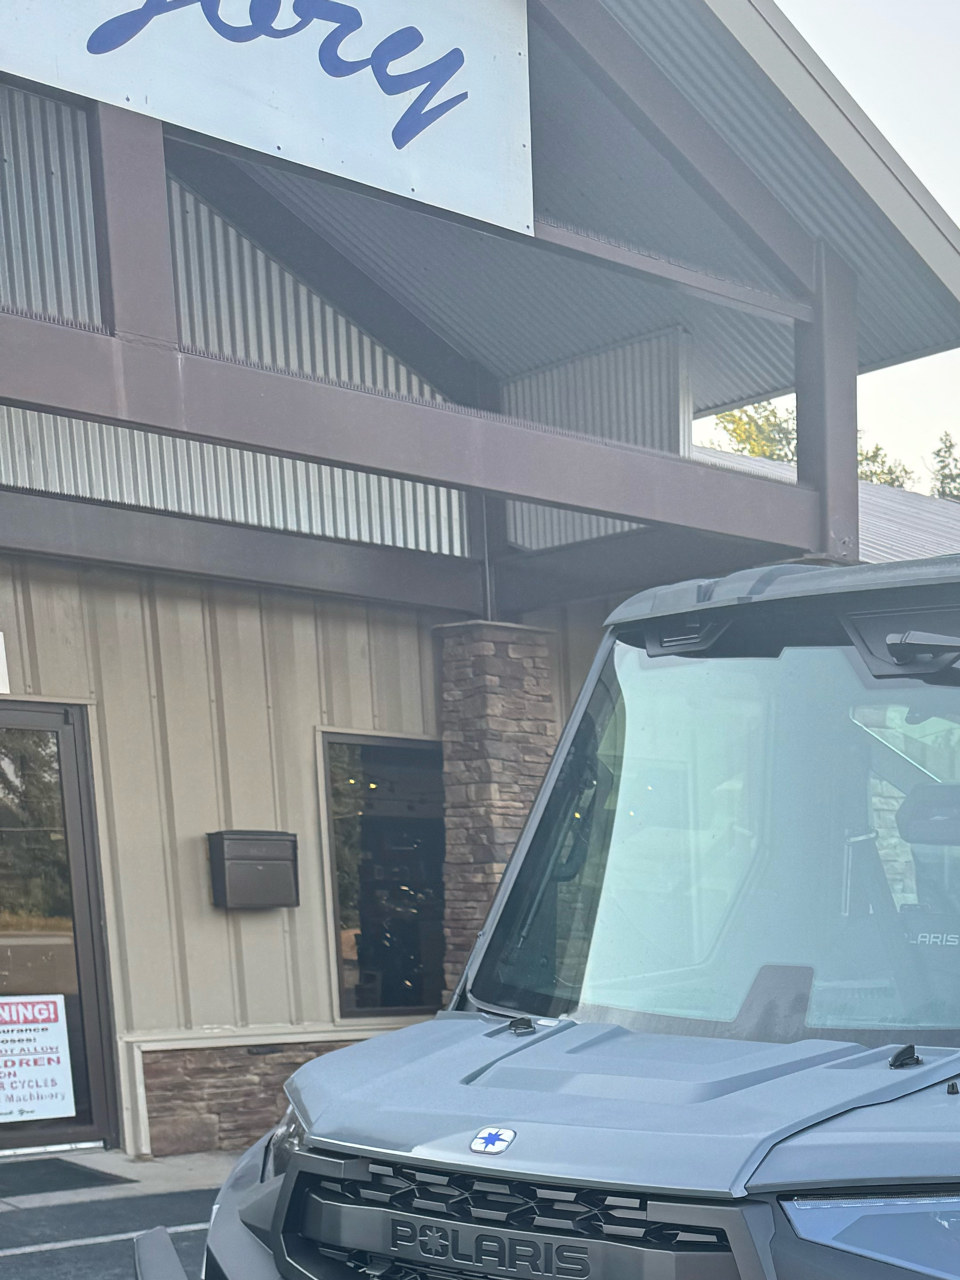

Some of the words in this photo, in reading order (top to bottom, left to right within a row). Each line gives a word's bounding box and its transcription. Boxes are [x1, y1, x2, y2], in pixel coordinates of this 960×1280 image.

[10, 1077, 58, 1090] CYCLES
[5, 1091, 66, 1103] Machinery
[390, 1218, 591, 1280] POLARIS
